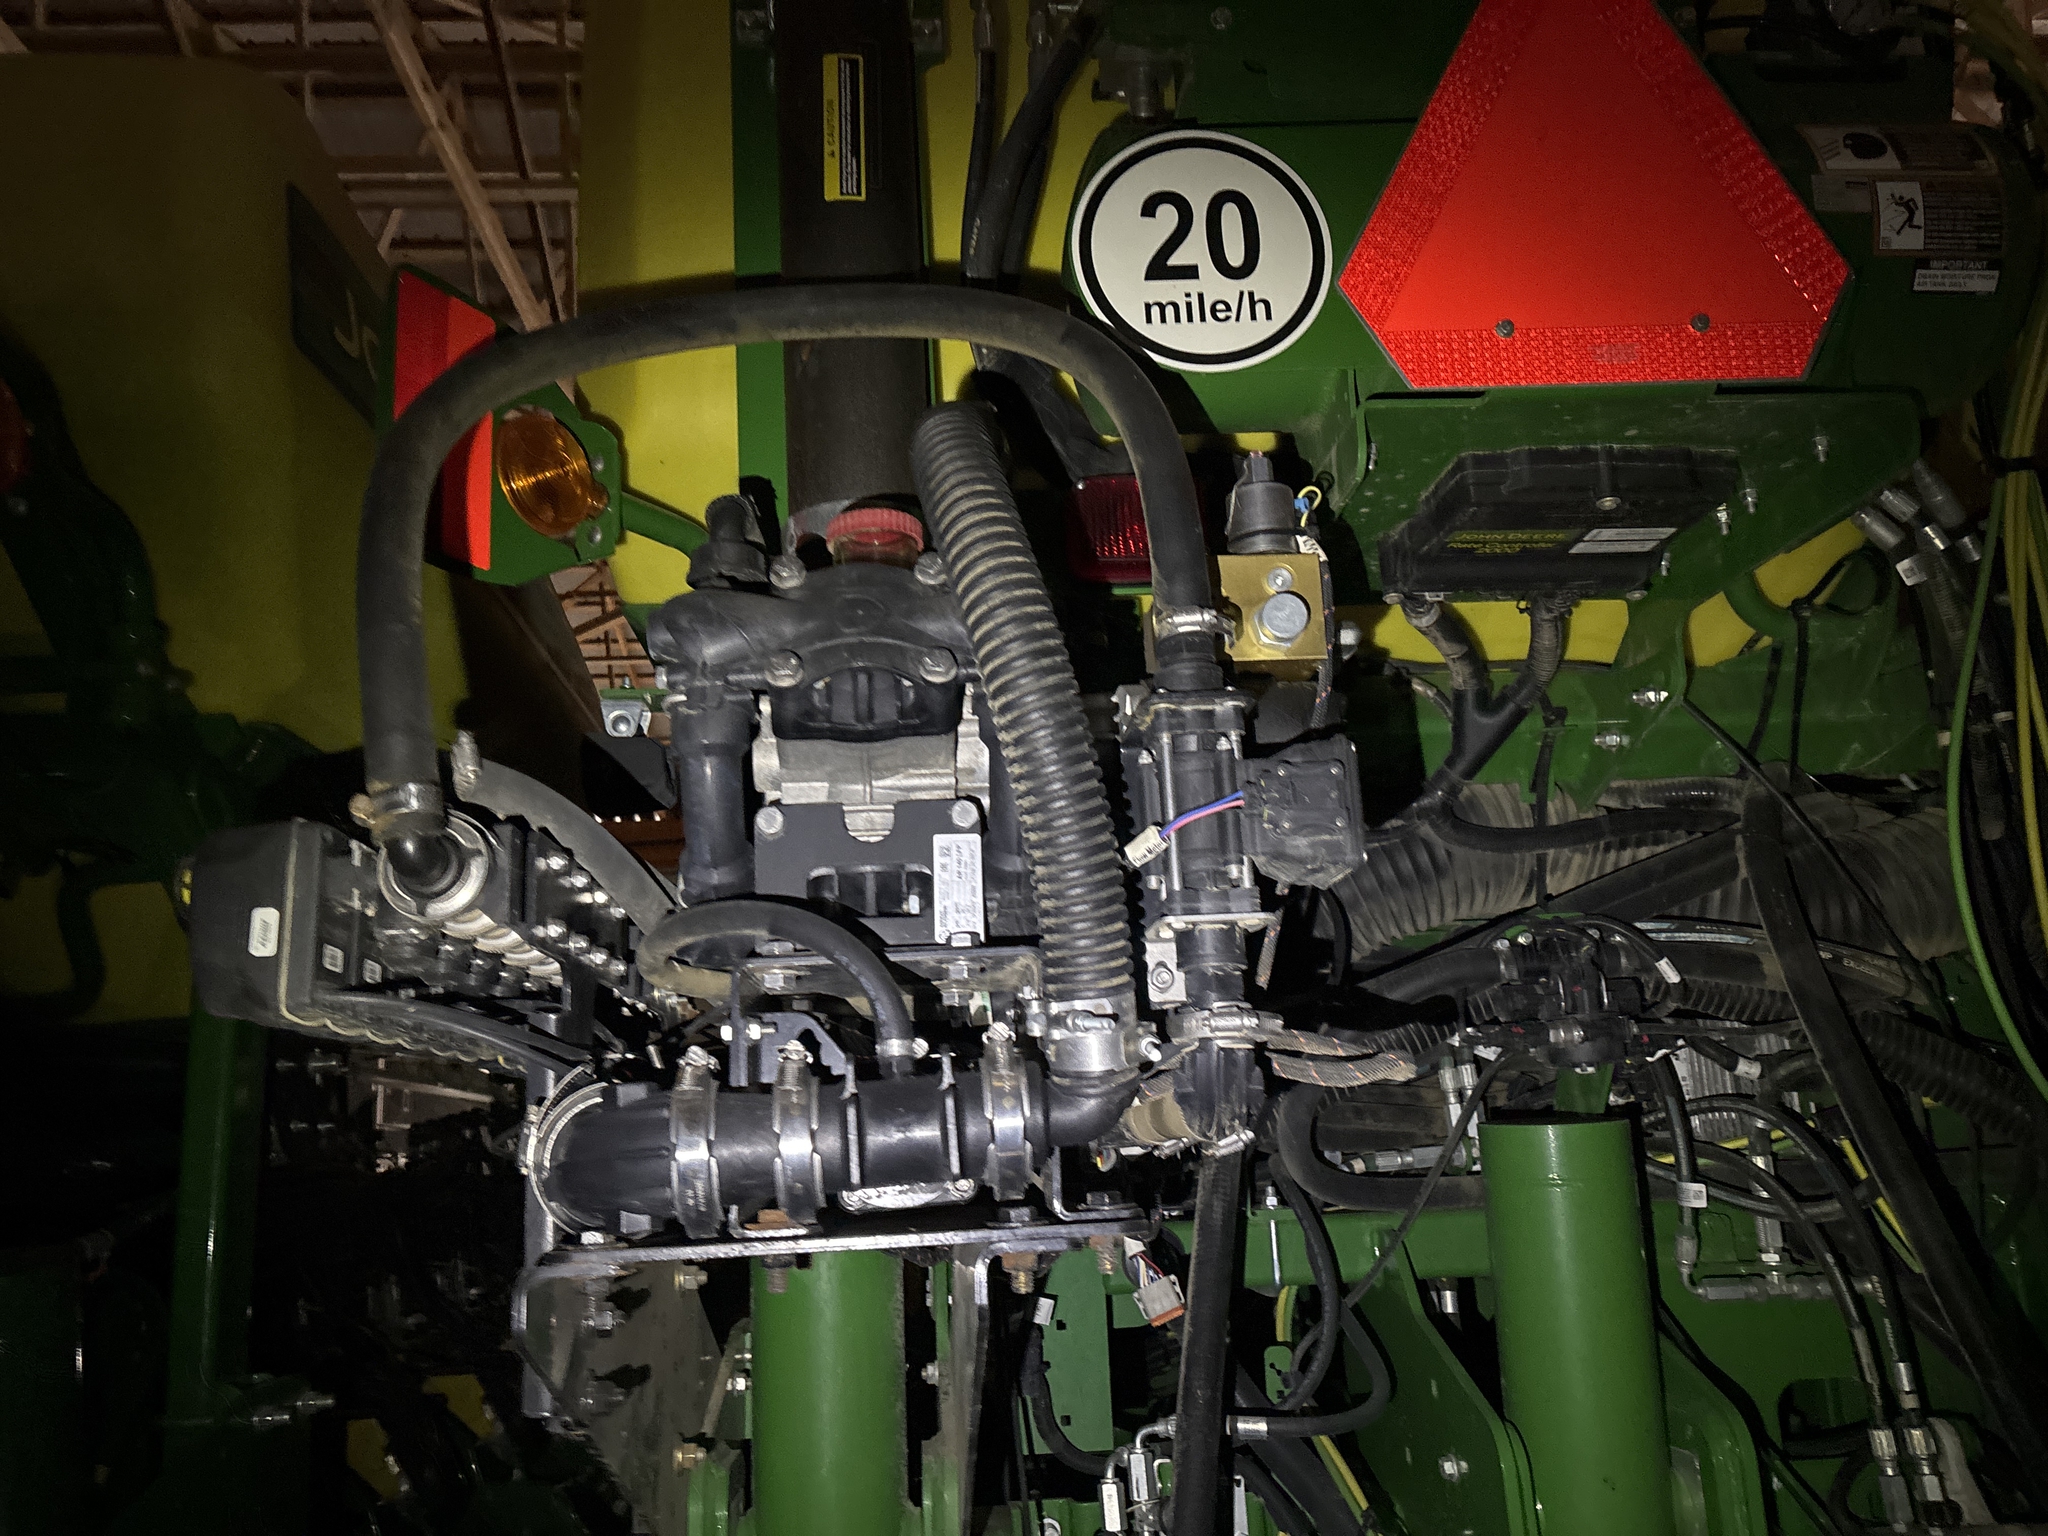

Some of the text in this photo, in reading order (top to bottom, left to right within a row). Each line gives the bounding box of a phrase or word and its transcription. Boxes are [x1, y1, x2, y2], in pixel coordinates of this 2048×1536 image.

[1140, 189, 1261, 281] 20
[1930, 260, 1988, 270] IMPORTANT
[1144, 290, 1273, 325] mile/h
